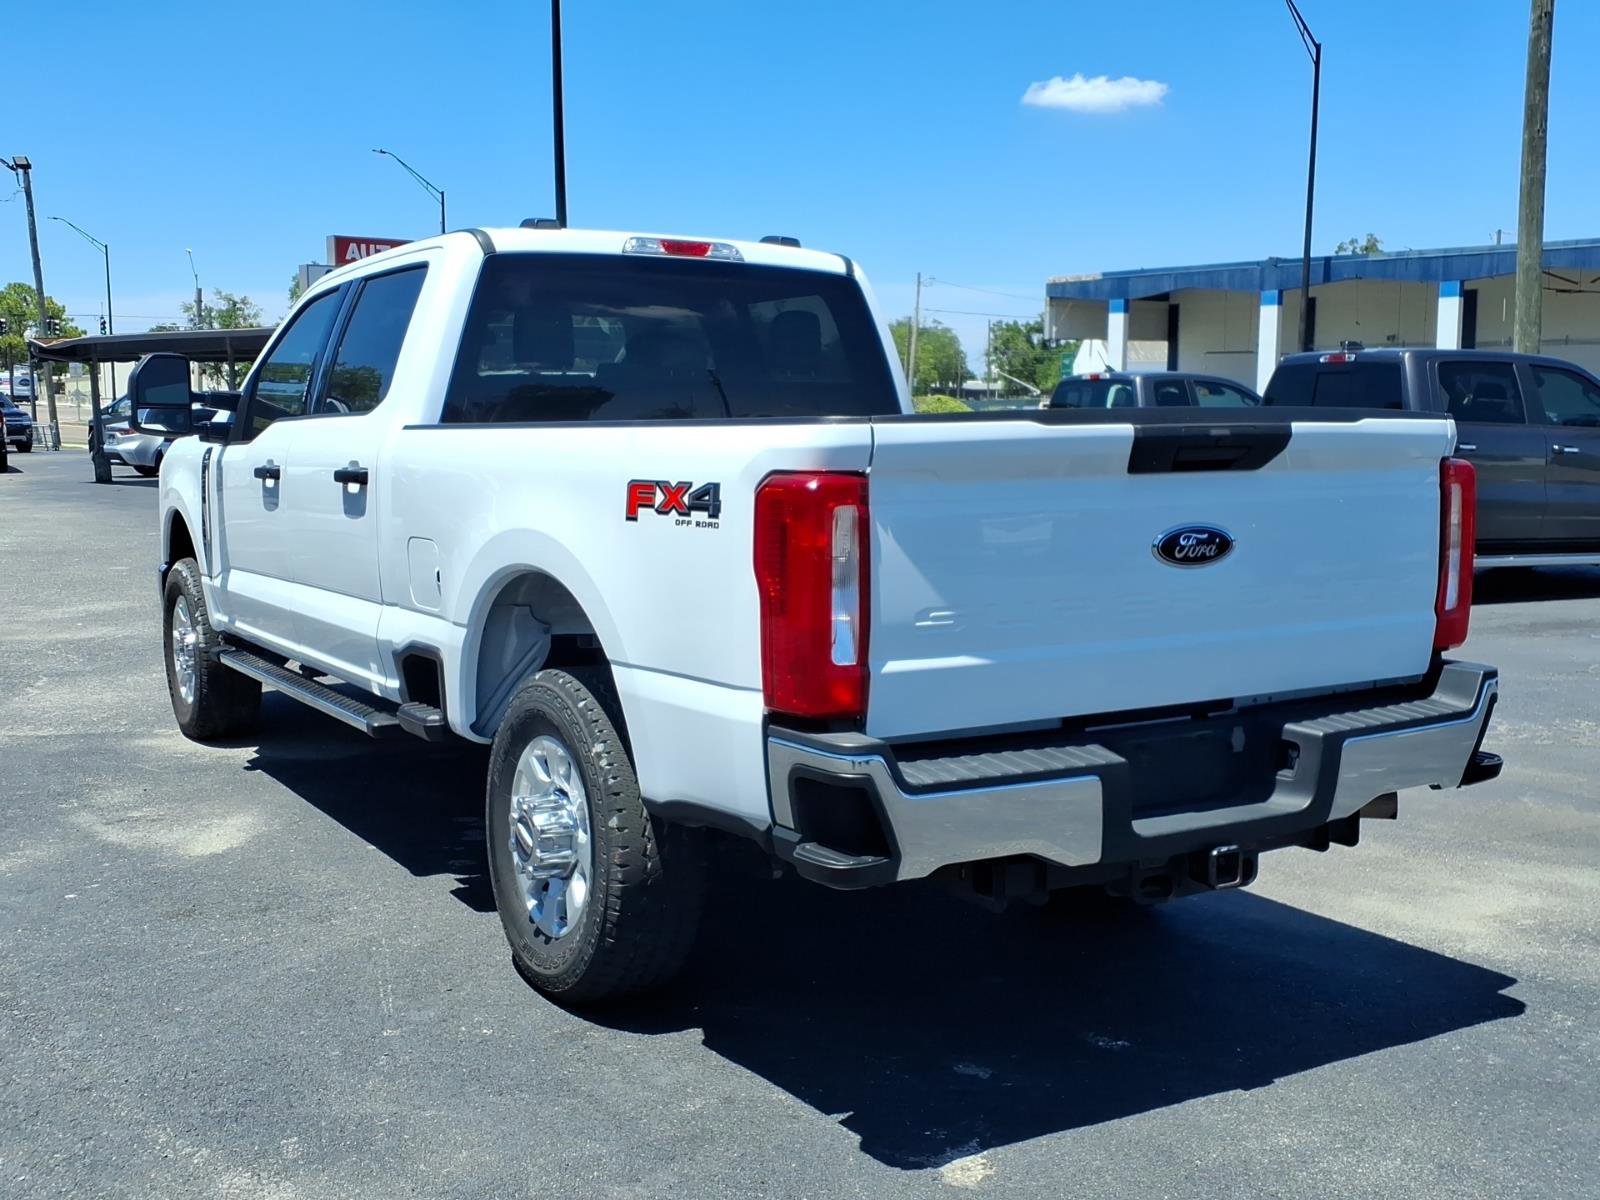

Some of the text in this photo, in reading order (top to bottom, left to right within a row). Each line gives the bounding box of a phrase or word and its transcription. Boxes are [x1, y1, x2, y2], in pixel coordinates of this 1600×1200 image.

[625, 478, 722, 522] FX4
[674, 518, 720, 530] OFF ROAD
[1174, 532, 1219, 559] Ford
